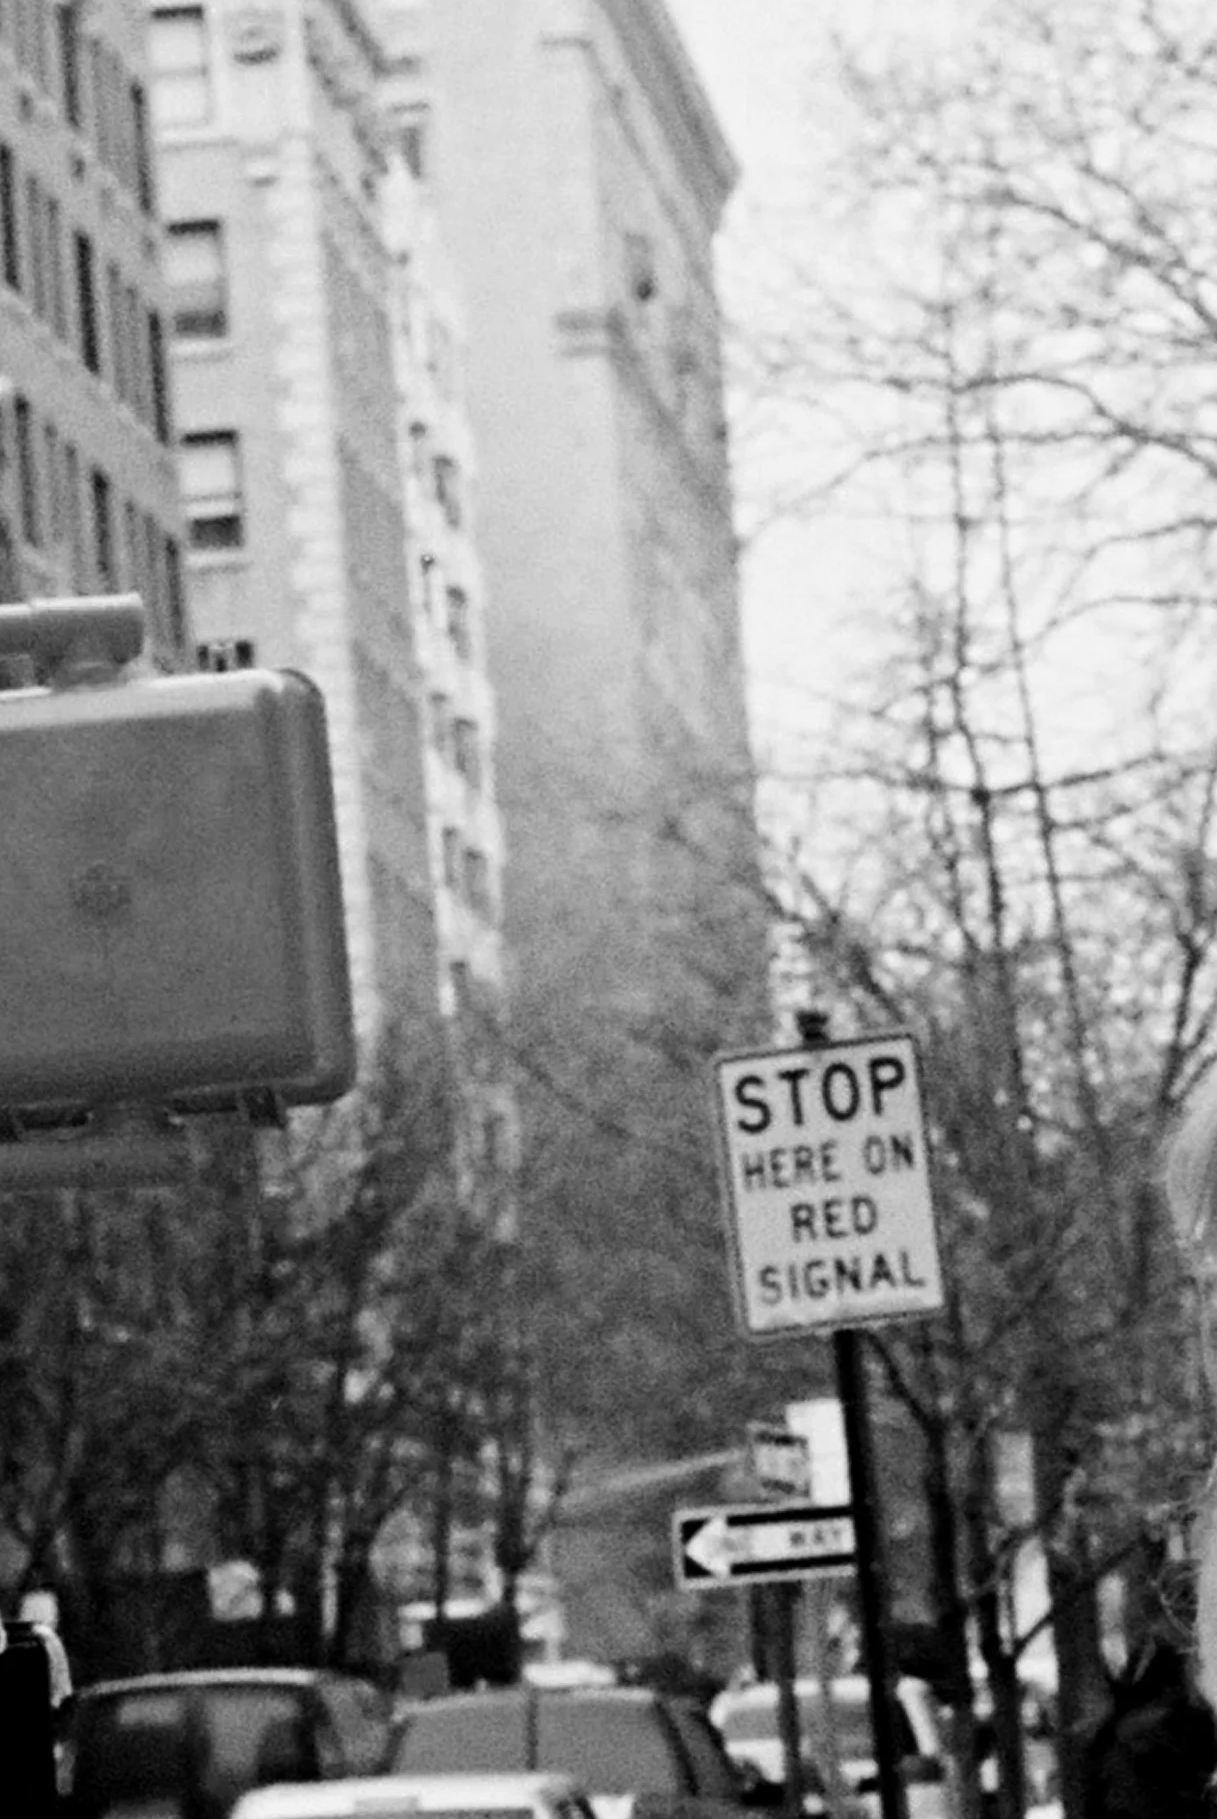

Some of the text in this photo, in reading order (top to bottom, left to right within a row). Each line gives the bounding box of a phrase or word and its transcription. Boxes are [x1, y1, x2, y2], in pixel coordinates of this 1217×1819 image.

[735, 1056, 906, 1135] STOP
[741, 1134, 915, 1191] HERE ON
[790, 1194, 879, 1243] RED
[758, 1250, 926, 1304] SIGNAL
